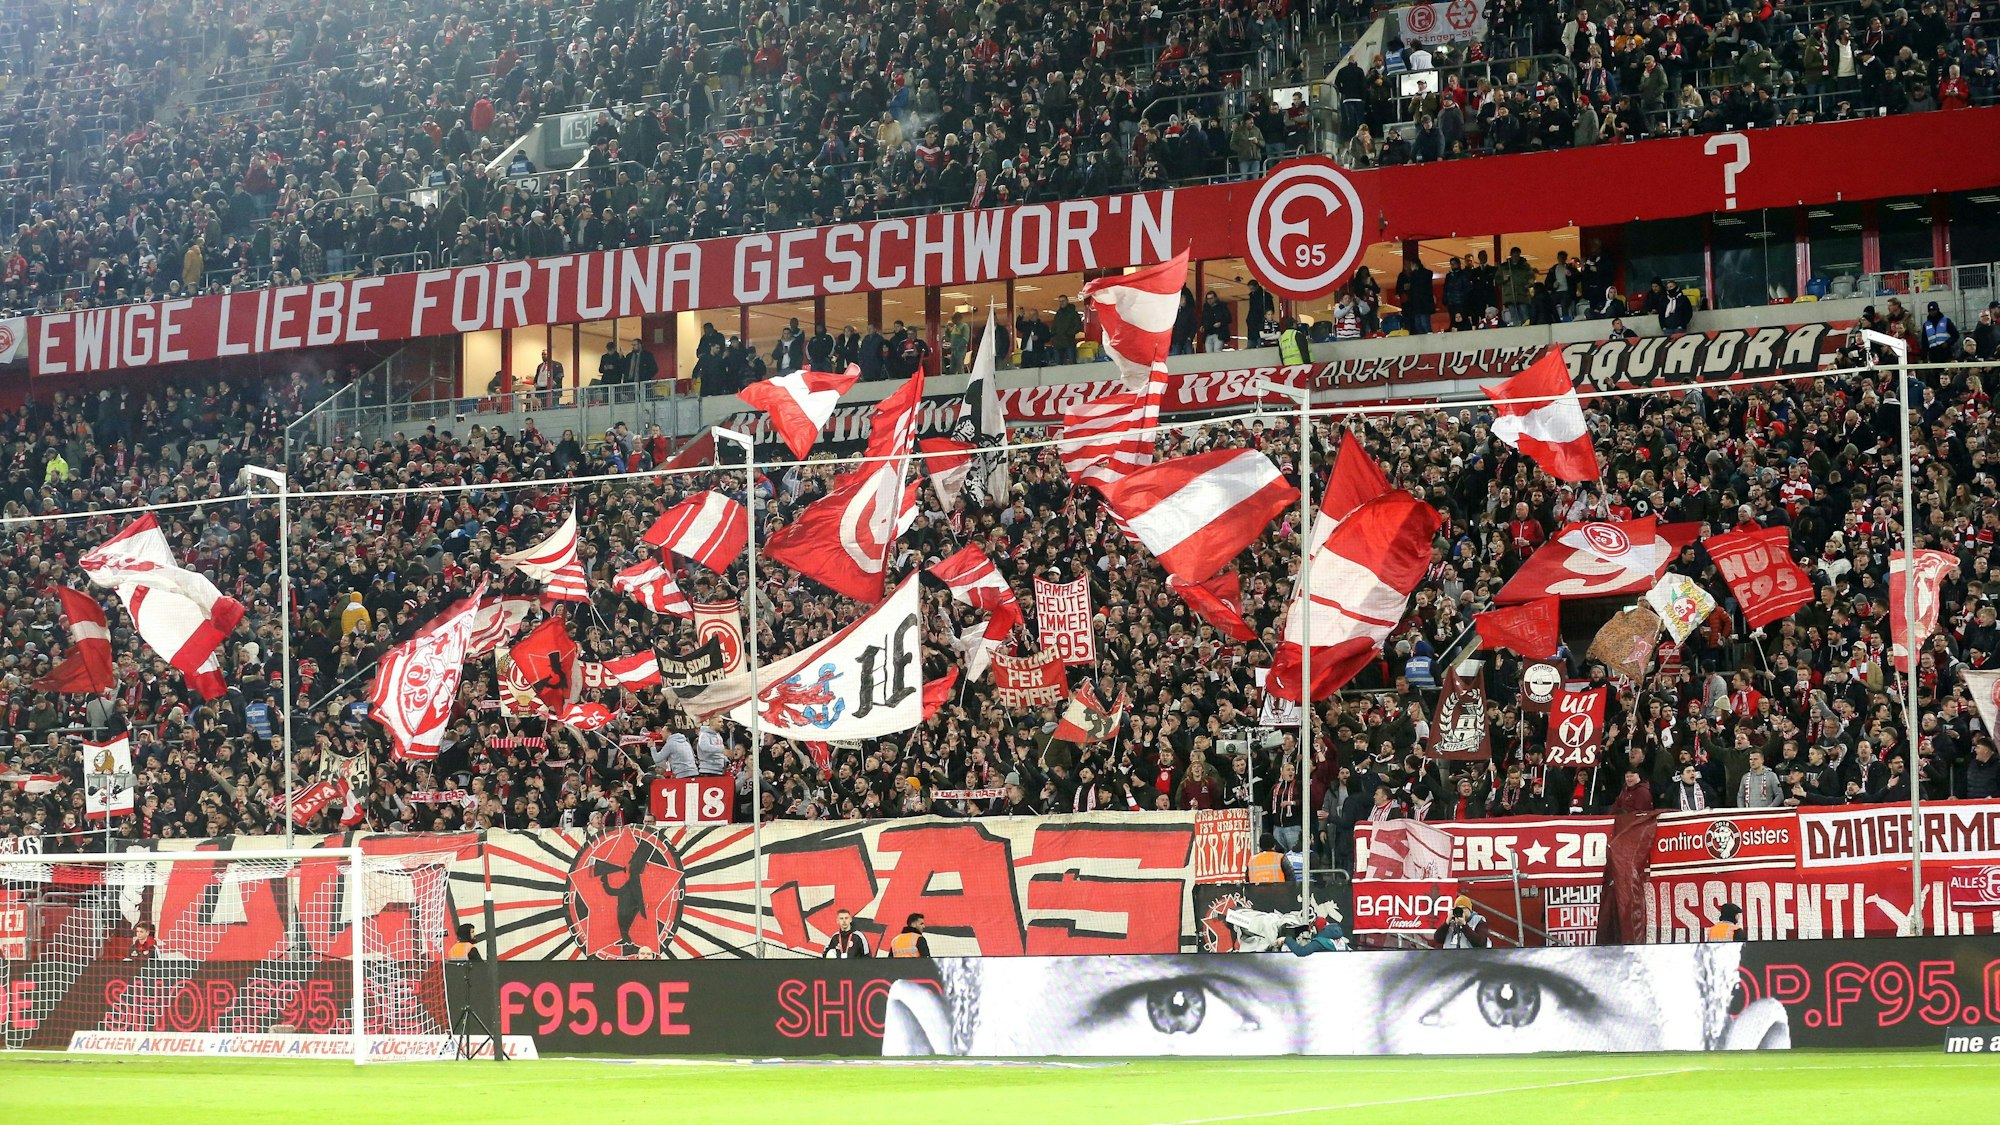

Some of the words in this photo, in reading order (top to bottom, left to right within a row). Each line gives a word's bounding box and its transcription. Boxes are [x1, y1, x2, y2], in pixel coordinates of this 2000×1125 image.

[1295, 243, 1325, 267] 95
[38, 297, 194, 375] EWIGE
[216, 276, 386, 357] LIEBE
[411, 243, 702, 331] FORTUNA
[732, 191, 1173, 303] GESCHWOR'N
[1563, 322, 1827, 391] SQUADRA
[1036, 580, 1085, 596] DAMALS
[1734, 567, 1798, 608] F95
[1037, 593, 1086, 613] HEUTE
[1039, 612, 1088, 631] IMMER
[1040, 630, 1089, 660] F95
[1007, 668, 1043, 688] PER
[999, 684, 1063, 708] SEMPRE
[1560, 693, 1599, 714] ULT
[1547, 744, 1597, 765] RAS
[1658, 832, 1703, 852] antira
[1742, 826, 1789, 845] sisters
[1950, 876, 1987, 889] ALLES
[1357, 895, 1454, 917] BANDA
[501, 981, 690, 1038] F95.DE
[74, 1036, 136, 1051] KÜCHEN
[138, 1038, 203, 1053] AKTUELL
[218, 1037, 286, 1054] KÜCHEN
[1947, 1035, 1984, 1053] me
